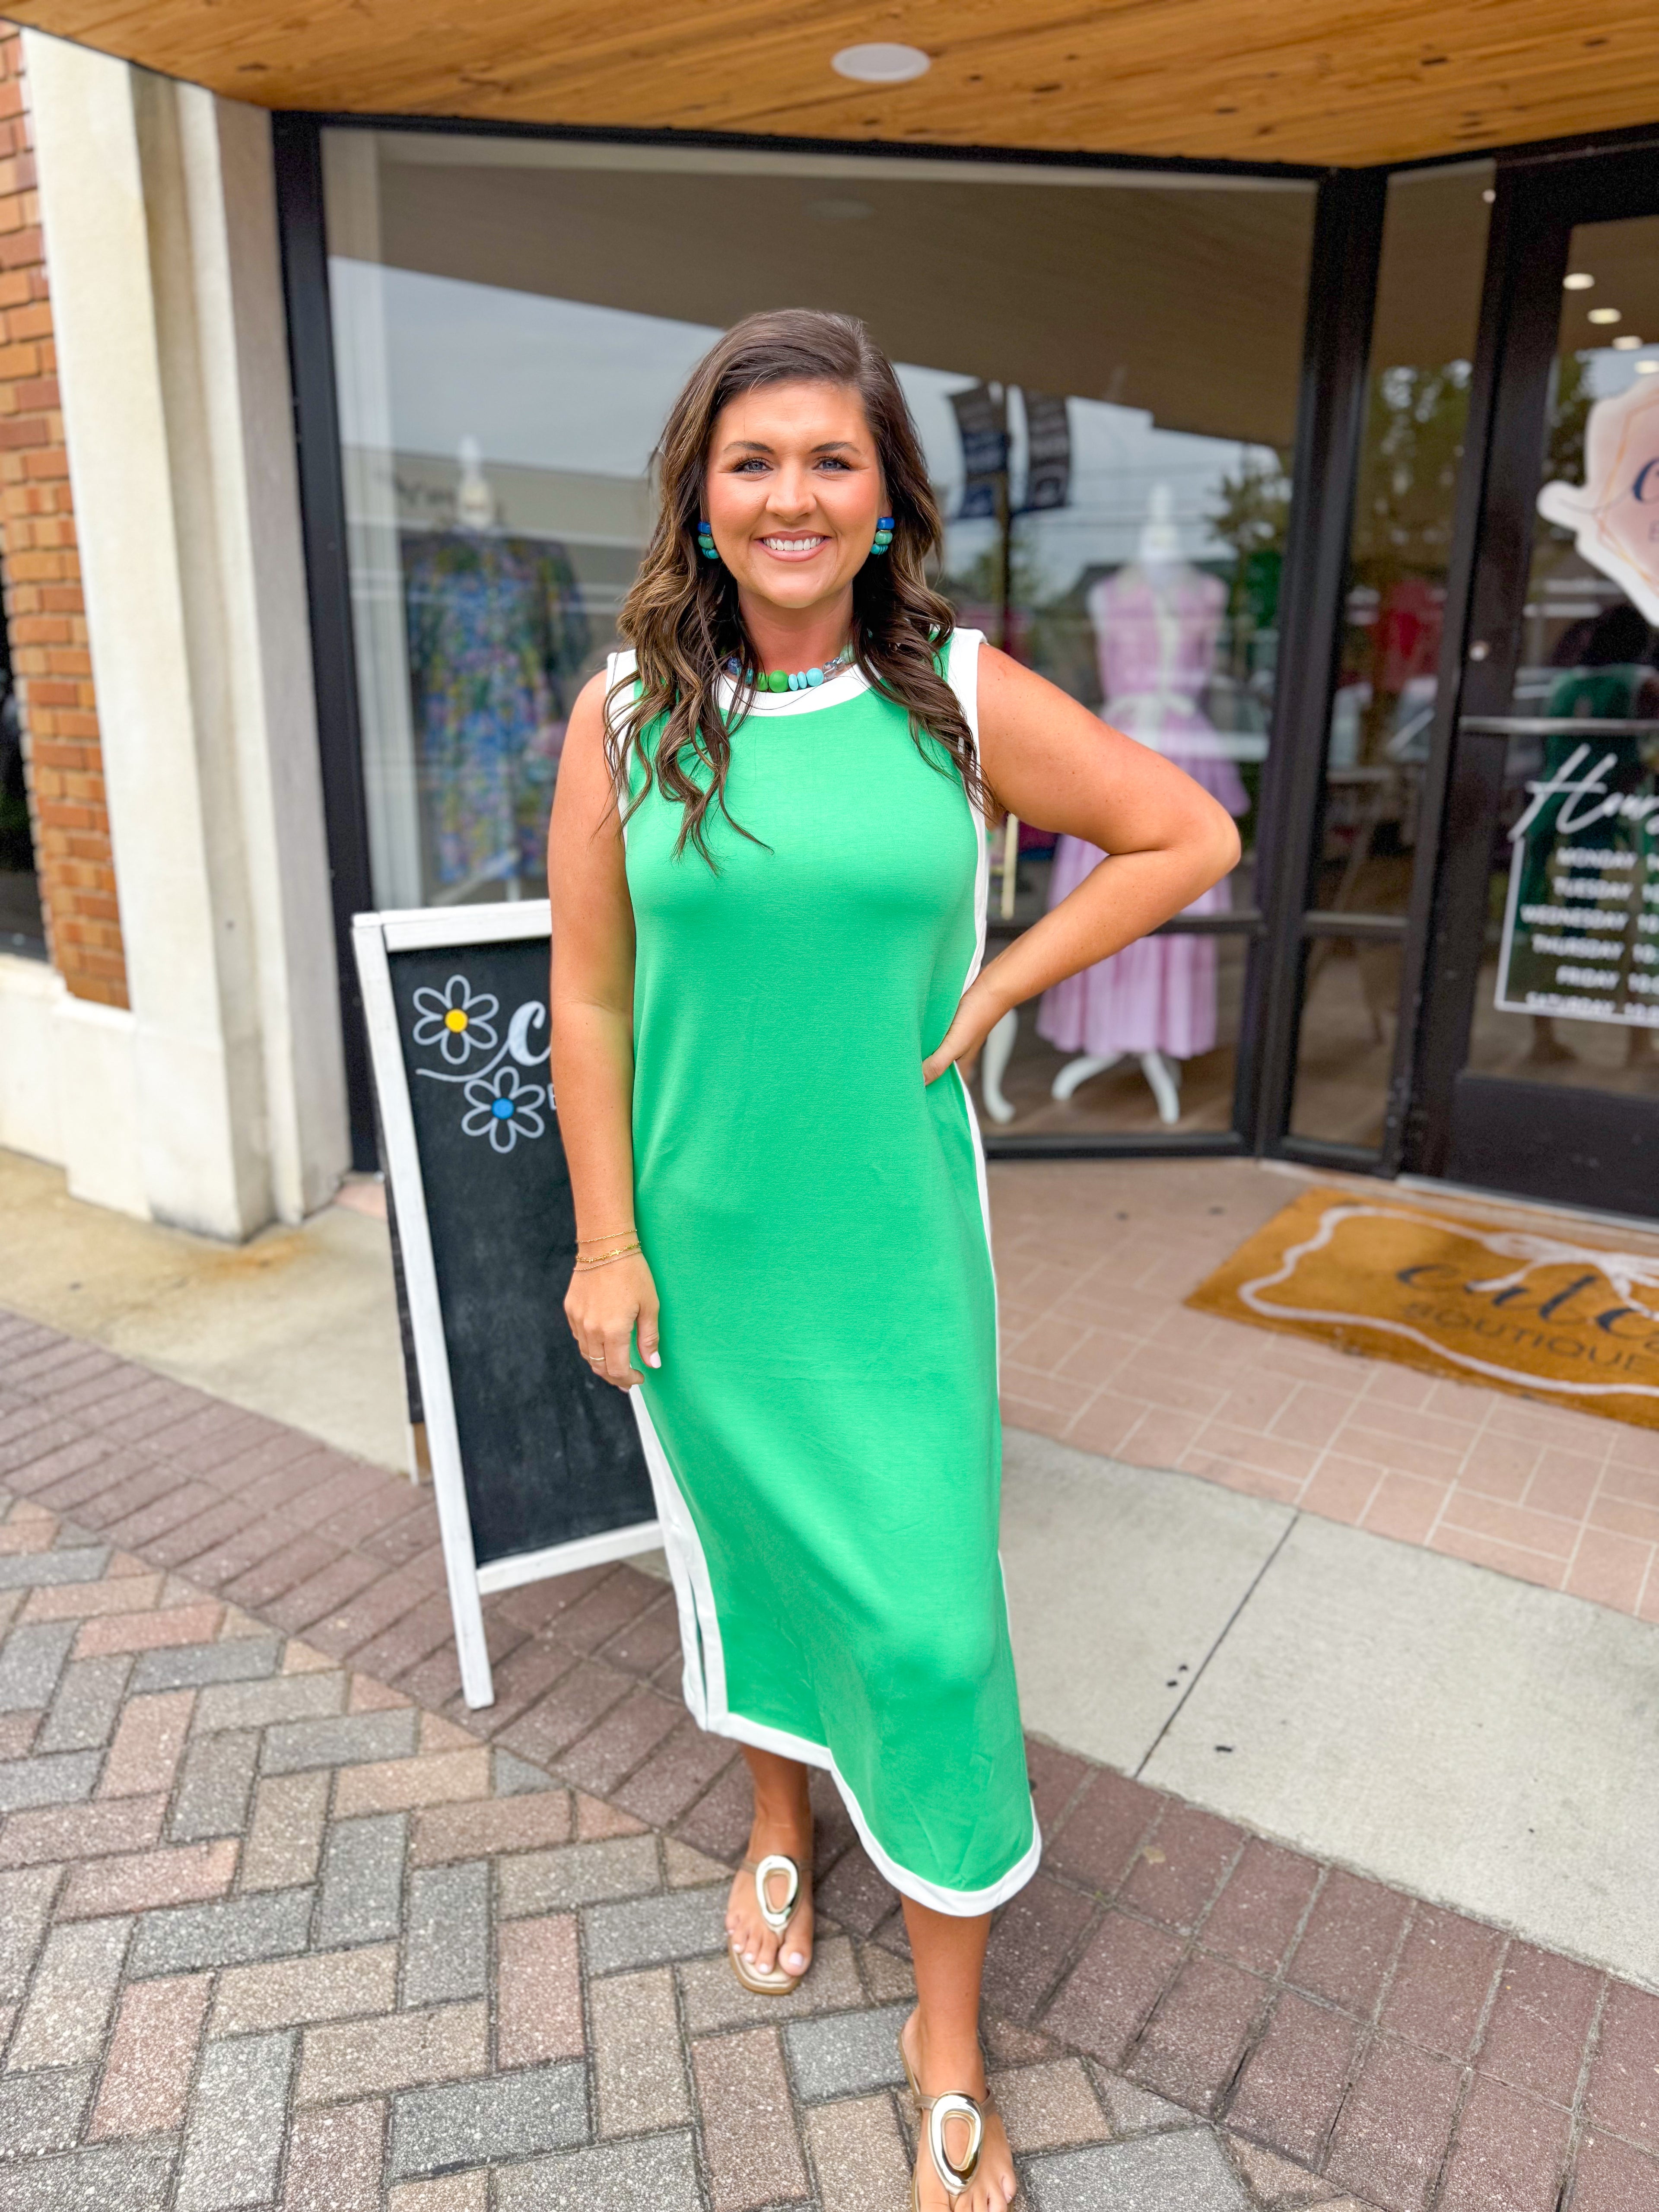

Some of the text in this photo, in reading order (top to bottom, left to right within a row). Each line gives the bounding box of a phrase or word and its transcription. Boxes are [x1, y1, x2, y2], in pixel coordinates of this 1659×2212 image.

[1556, 847, 1638, 870] MONDAY
[1553, 877, 1635, 900] TUESDAY
[1520, 904, 1630, 931] WEDNESDAY
[1532, 934, 1625, 960] THURSDAY
[1556, 965, 1620, 990] FRIDAY
